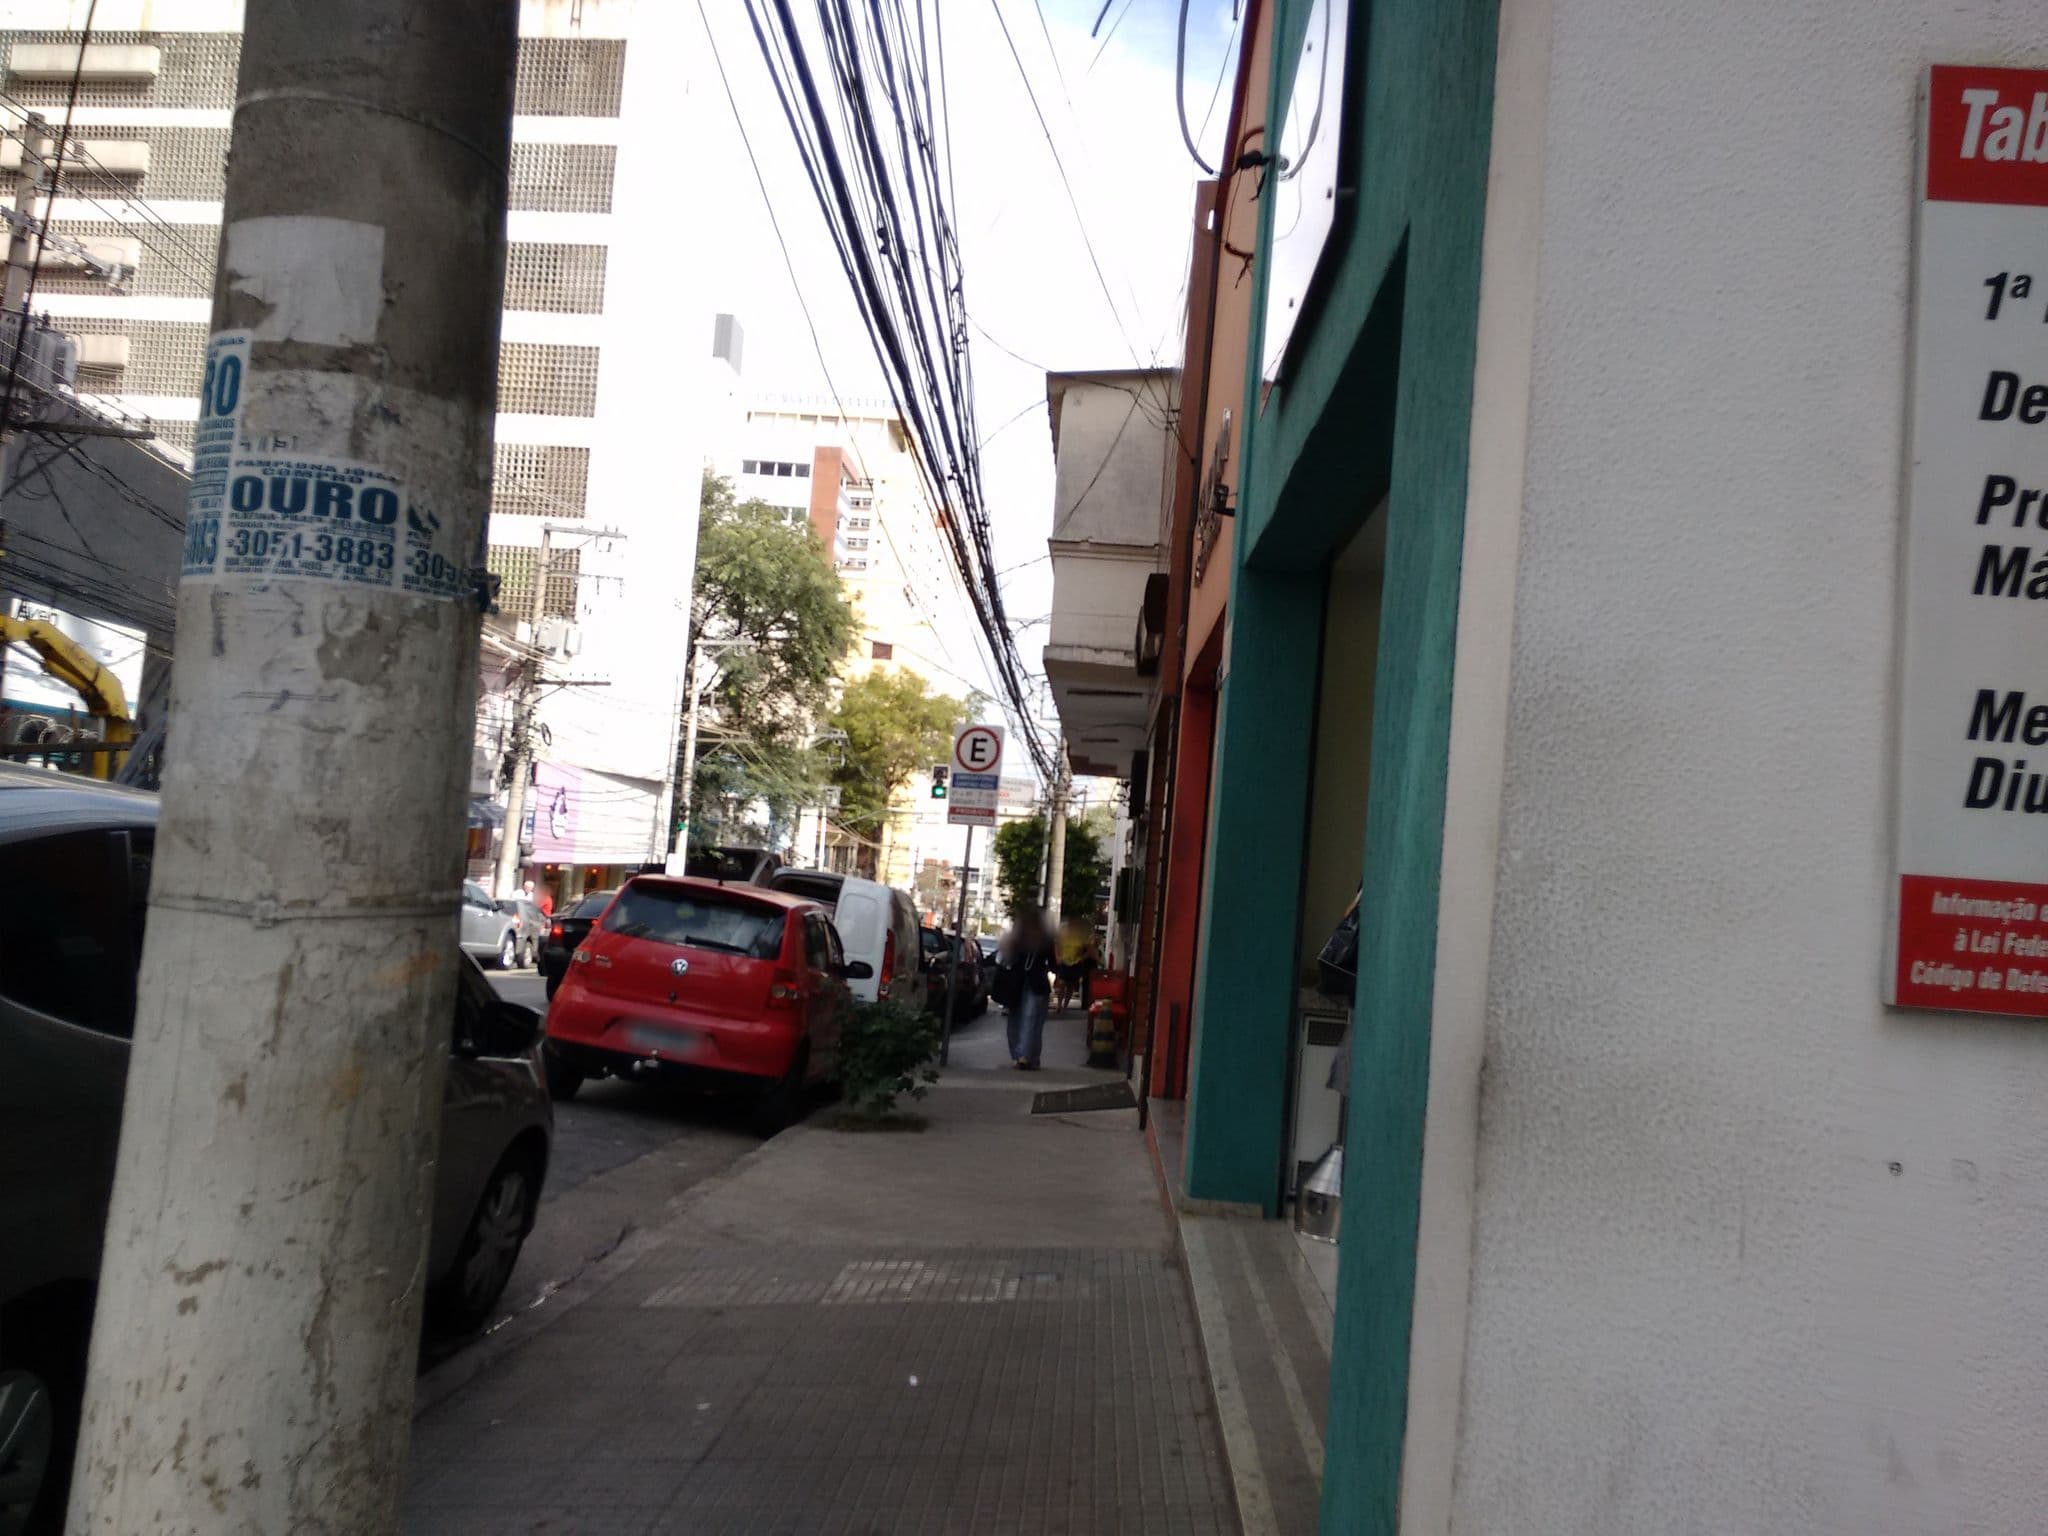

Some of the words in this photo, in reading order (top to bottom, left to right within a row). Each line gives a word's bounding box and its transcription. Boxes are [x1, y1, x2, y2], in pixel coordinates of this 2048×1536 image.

[231, 476, 398, 525] OURO
[234, 529, 394, 570] 3051-3883
[970, 737, 988, 762] E
